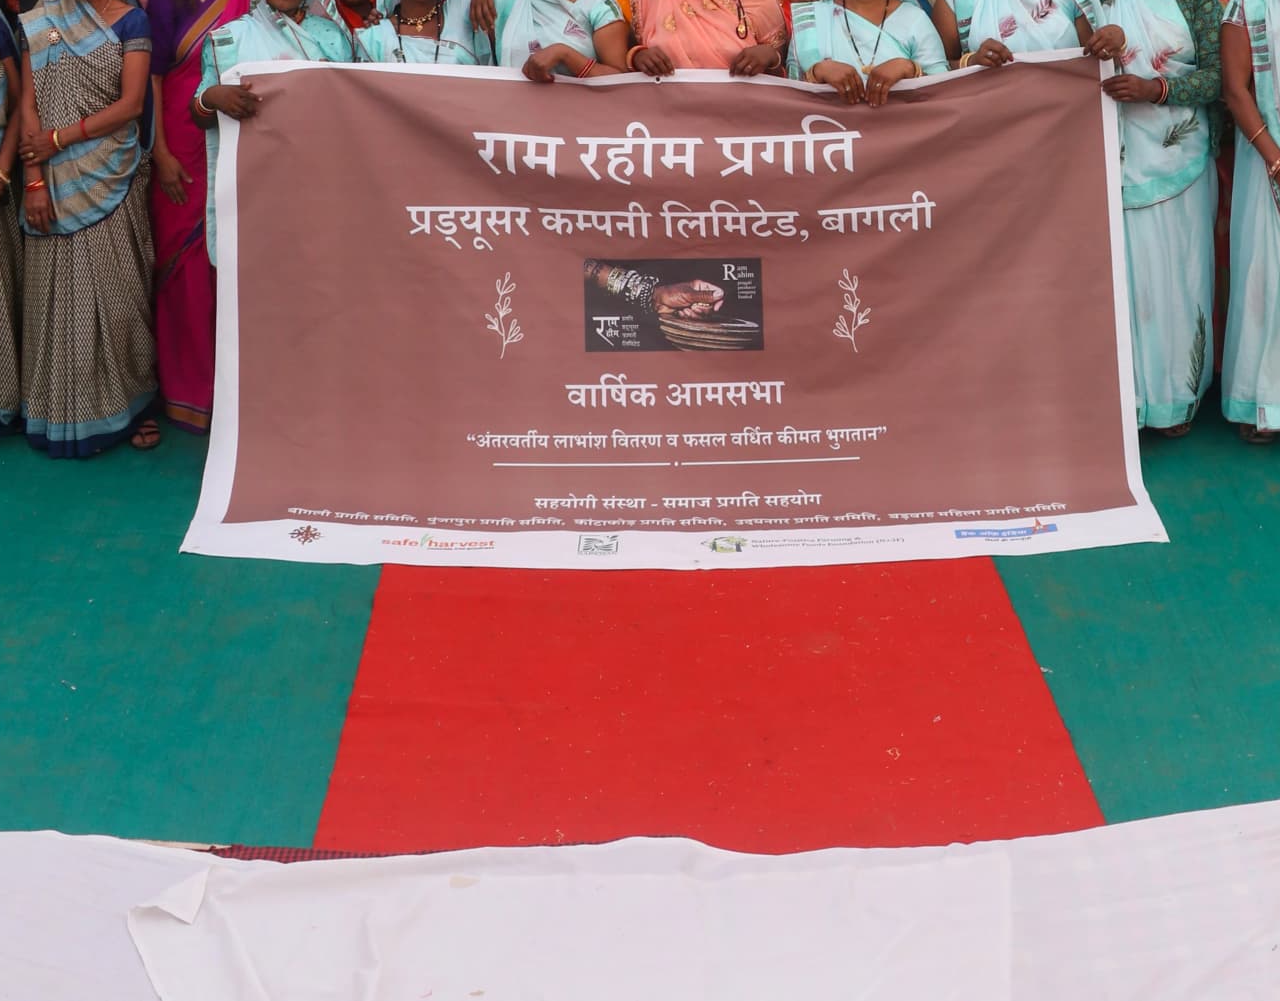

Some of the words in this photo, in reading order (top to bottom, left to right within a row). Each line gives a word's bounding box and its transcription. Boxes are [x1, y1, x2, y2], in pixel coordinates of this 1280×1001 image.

[472, 131, 565, 178] राम
[576, 121, 704, 185] रहीम
[714, 114, 862, 177] प्रगति
[405, 206, 531, 251] प्रड्यूसर
[537, 201, 652, 239] कम्पनी
[659, 199, 809, 242] लिमिटेड,
[817, 191, 937, 233] बागली
[565, 373, 658, 408] वार्षिक
[665, 380, 785, 407] आमसभा
[553, 431, 607, 449] लाभांश
[611, 428, 663, 449] वितरण
[666, 433, 679, 448] व
[683, 433, 727, 448] फसल
[730, 426, 773, 447] वर्धित
[776, 426, 822, 445] कीमत
[825, 426, 887, 450] भुगतान”
[534, 493, 598, 509] सहयोगी
[601, 495, 647, 510] संस्था
[662, 496, 712, 509] समाज
[716, 490, 760, 508] प्रगति
[764, 489, 822, 507] सहयोग
[335, 511, 370, 521] प्रगति
[640, 517, 675, 527] प्रगति
[793, 514, 830, 524] प्रगति
[984, 505, 1020, 516] प्रगति
[381, 538, 419, 548] safe
[427, 539, 496, 548] harvest
